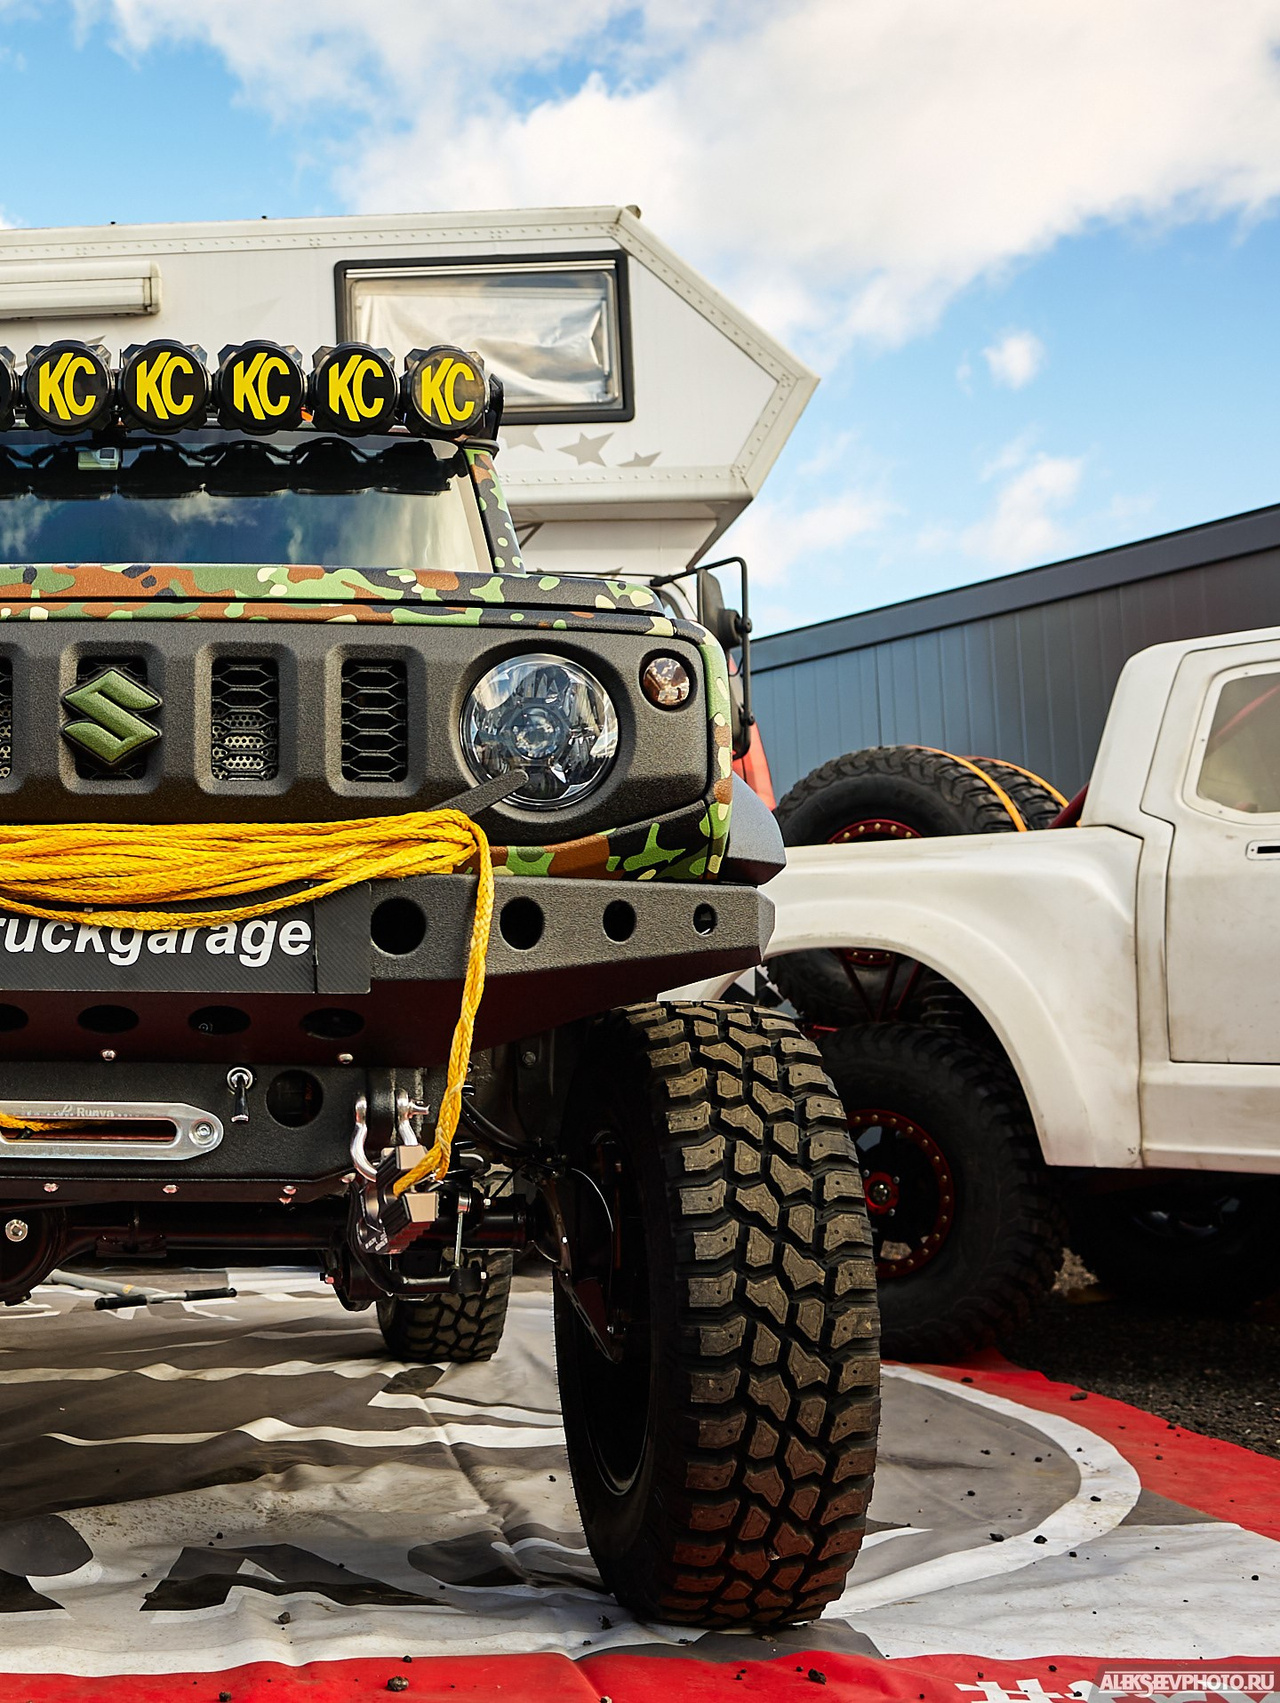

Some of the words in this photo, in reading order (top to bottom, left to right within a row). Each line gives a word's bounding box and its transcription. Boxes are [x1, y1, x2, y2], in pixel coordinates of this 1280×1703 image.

[39, 353, 96, 420] KC
[137, 352, 193, 419] KC
[234, 353, 290, 420] KC
[329, 355, 384, 421] KC
[421, 358, 475, 424] KC
